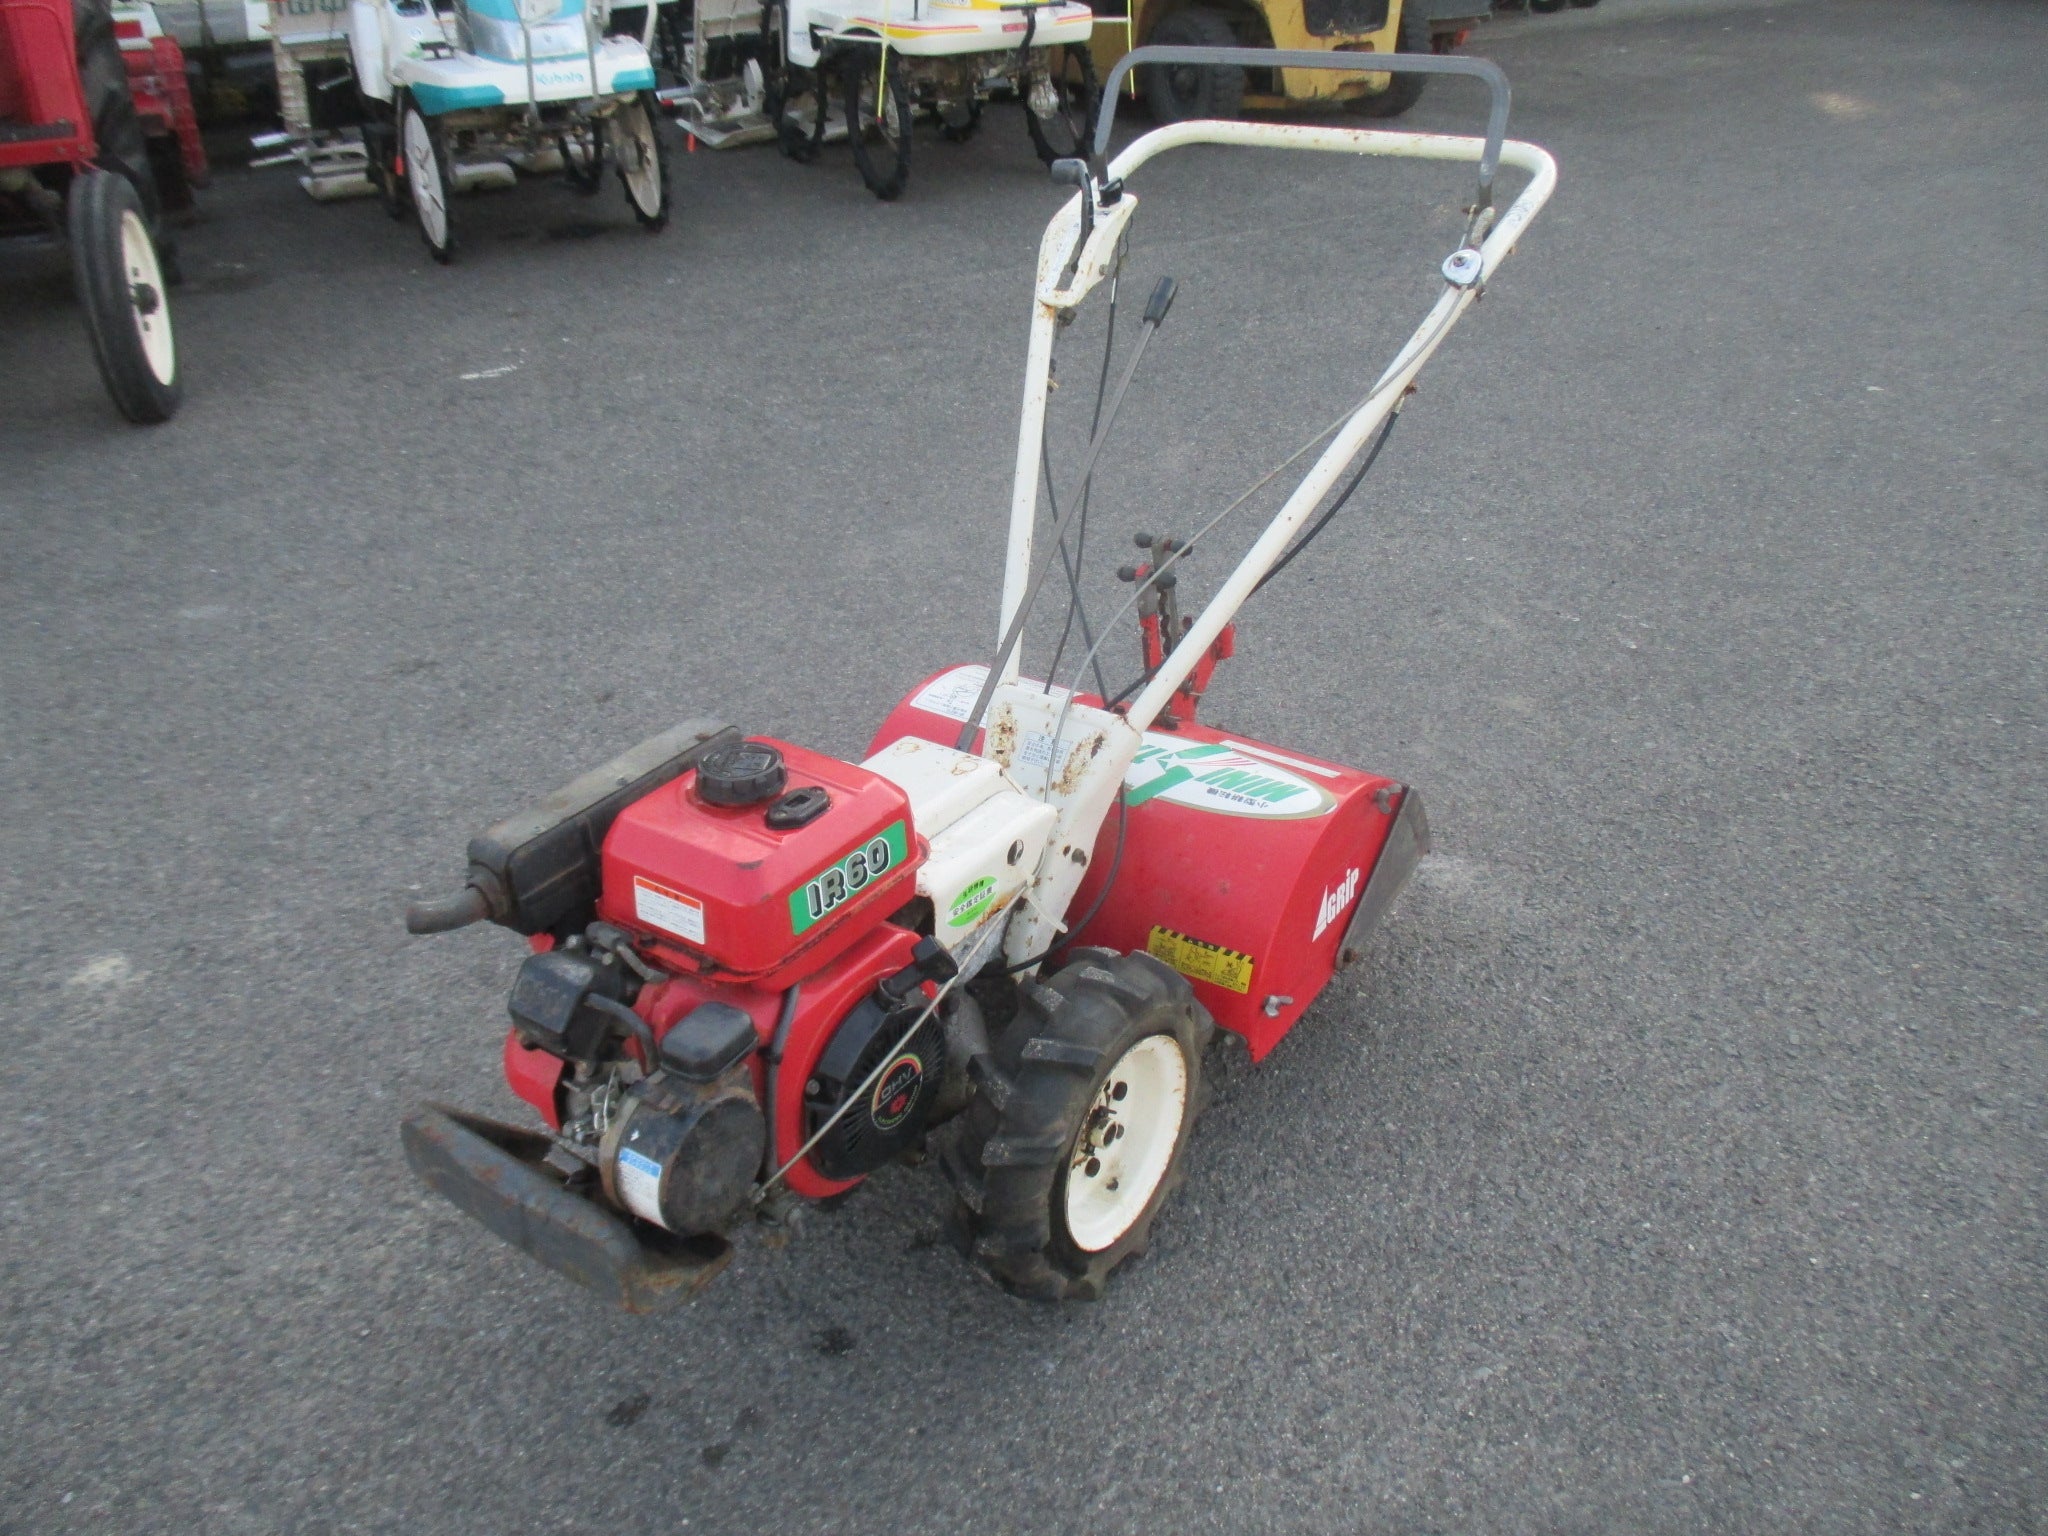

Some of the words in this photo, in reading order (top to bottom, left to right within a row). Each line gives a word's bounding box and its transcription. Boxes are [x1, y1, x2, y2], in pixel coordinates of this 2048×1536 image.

[536, 72, 584, 86] Kubota
[1195, 767, 1309, 803] MINI
[806, 837, 890, 920] IR60
